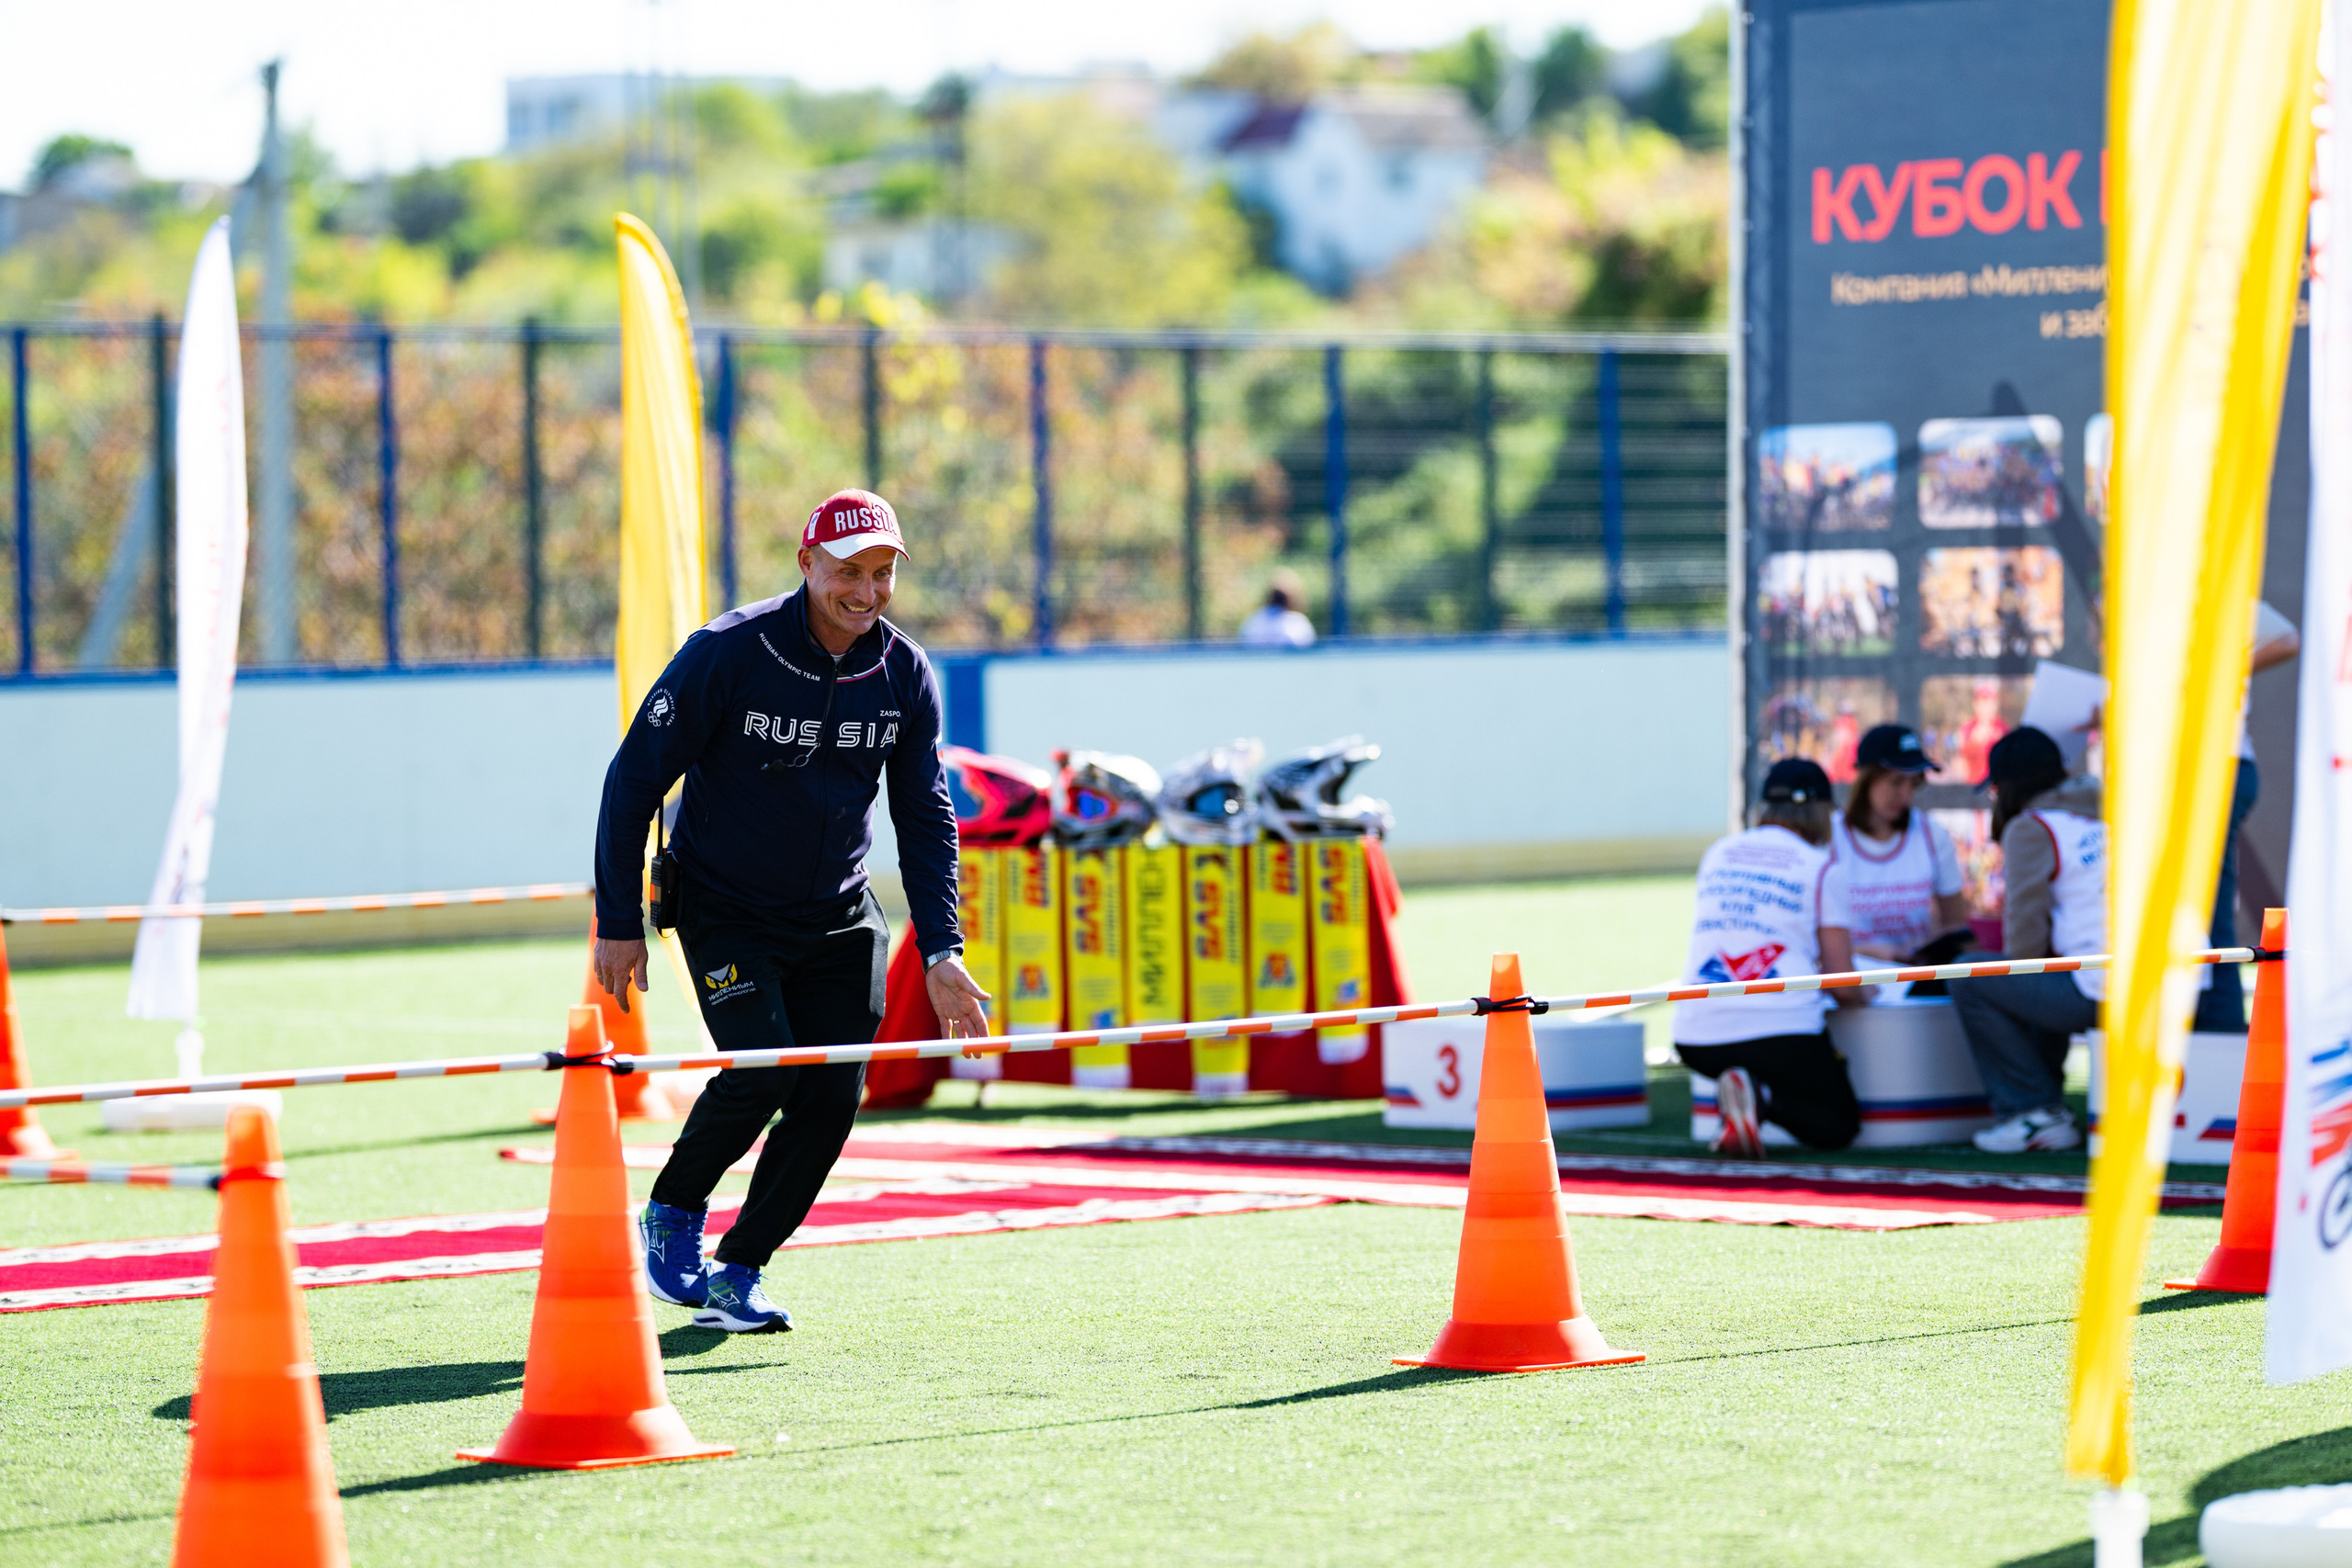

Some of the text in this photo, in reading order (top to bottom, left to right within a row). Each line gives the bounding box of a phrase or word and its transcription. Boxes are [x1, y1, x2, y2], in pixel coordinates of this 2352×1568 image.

[1812, 149, 2083, 245] КУБОК
[1831, 272, 1968, 306] Компания
[834, 507, 898, 536] RUSSIA
[758, 632, 820, 682] RUSSIAN OLYMPIC TEAM
[708, 981, 754, 1001] МИЛЛЕНИУМ
[1437, 1043, 1463, 1100] 3
